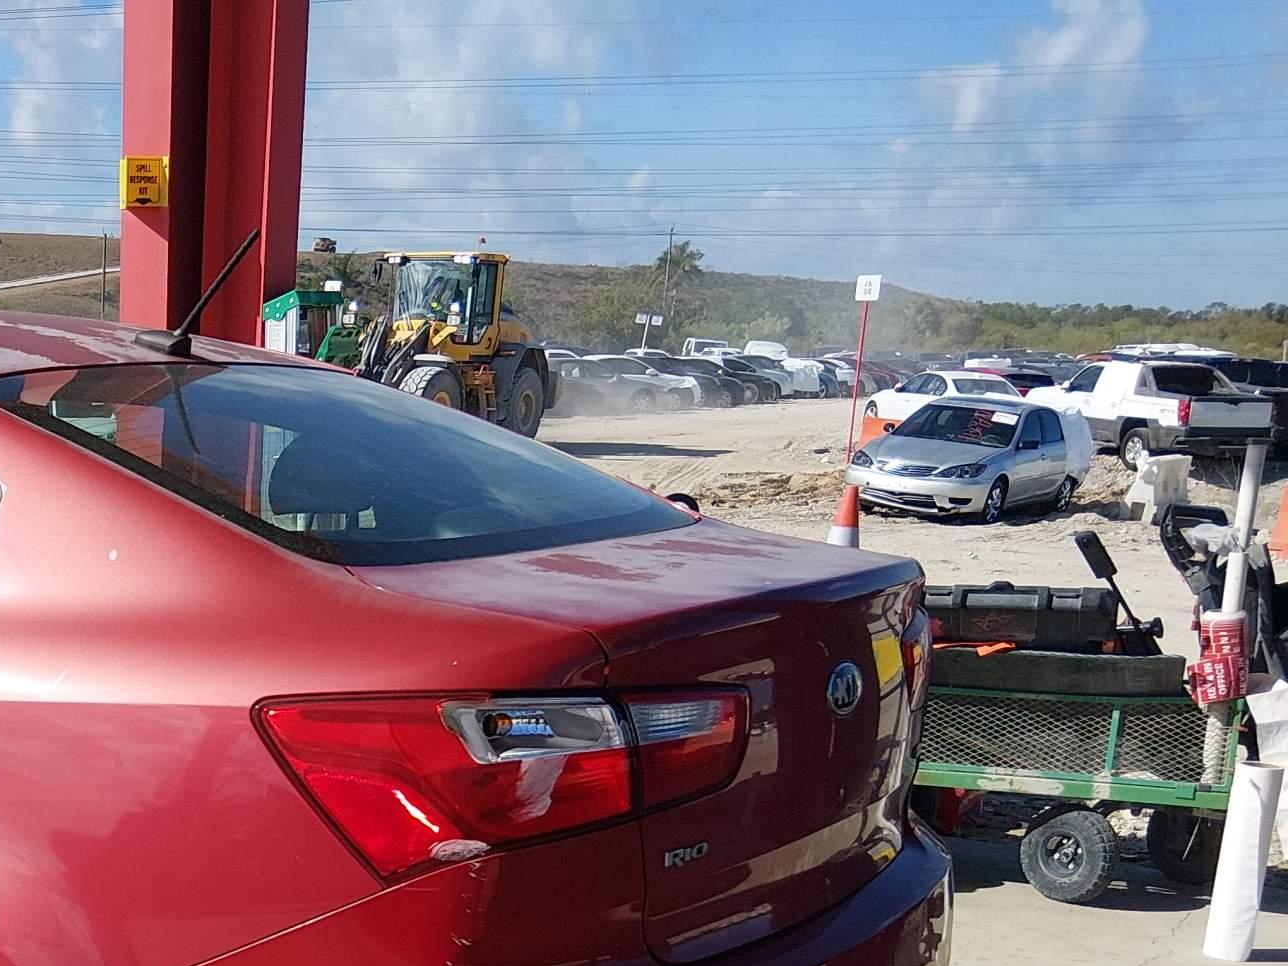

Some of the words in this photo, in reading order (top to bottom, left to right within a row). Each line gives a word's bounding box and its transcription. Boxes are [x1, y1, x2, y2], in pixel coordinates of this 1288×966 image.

[136, 164, 152, 172] SPILL
[129, 175, 158, 184] RESPONSE
[138, 187, 148, 195] KIT
[1203, 662, 1213, 673] IN
[1214, 662, 1227, 695] OFFICE
